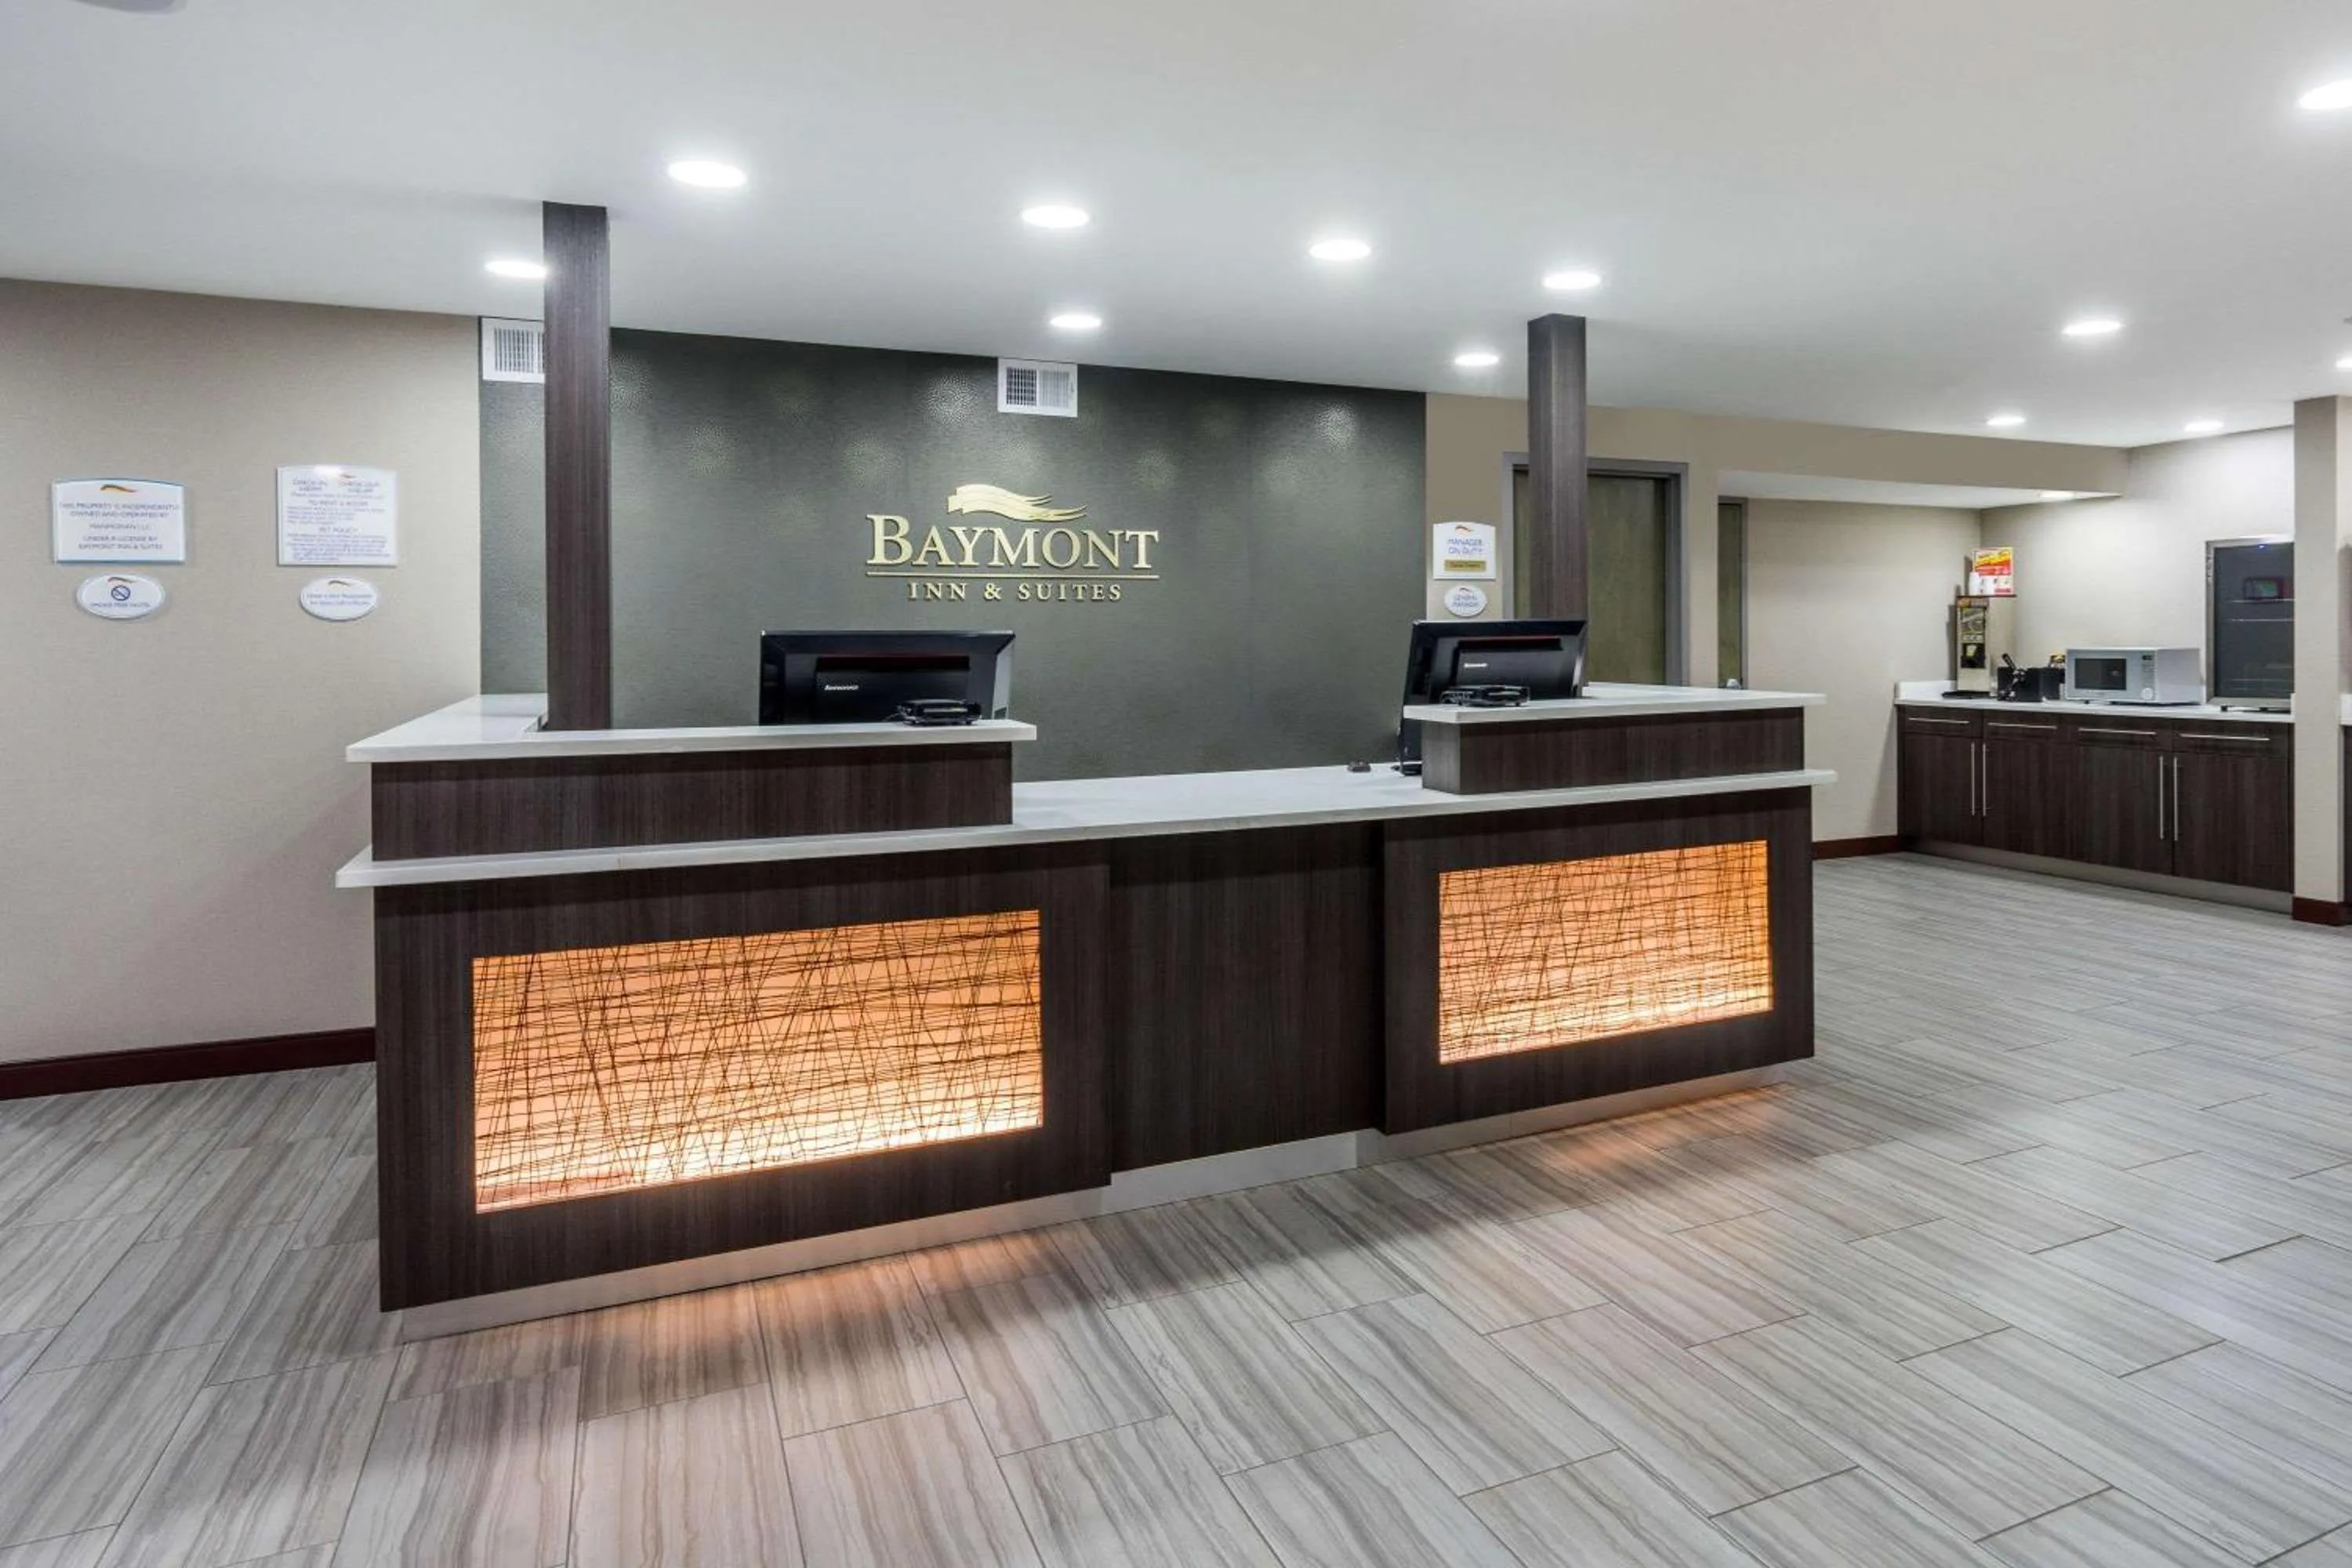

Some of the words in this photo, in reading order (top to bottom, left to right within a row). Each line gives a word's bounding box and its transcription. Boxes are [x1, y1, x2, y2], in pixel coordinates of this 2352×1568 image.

[866, 514, 1160, 569] BAYMONT
[908, 583, 968, 601] INN
[984, 583, 1003, 601] &
[1018, 583, 1123, 601] SUITES
